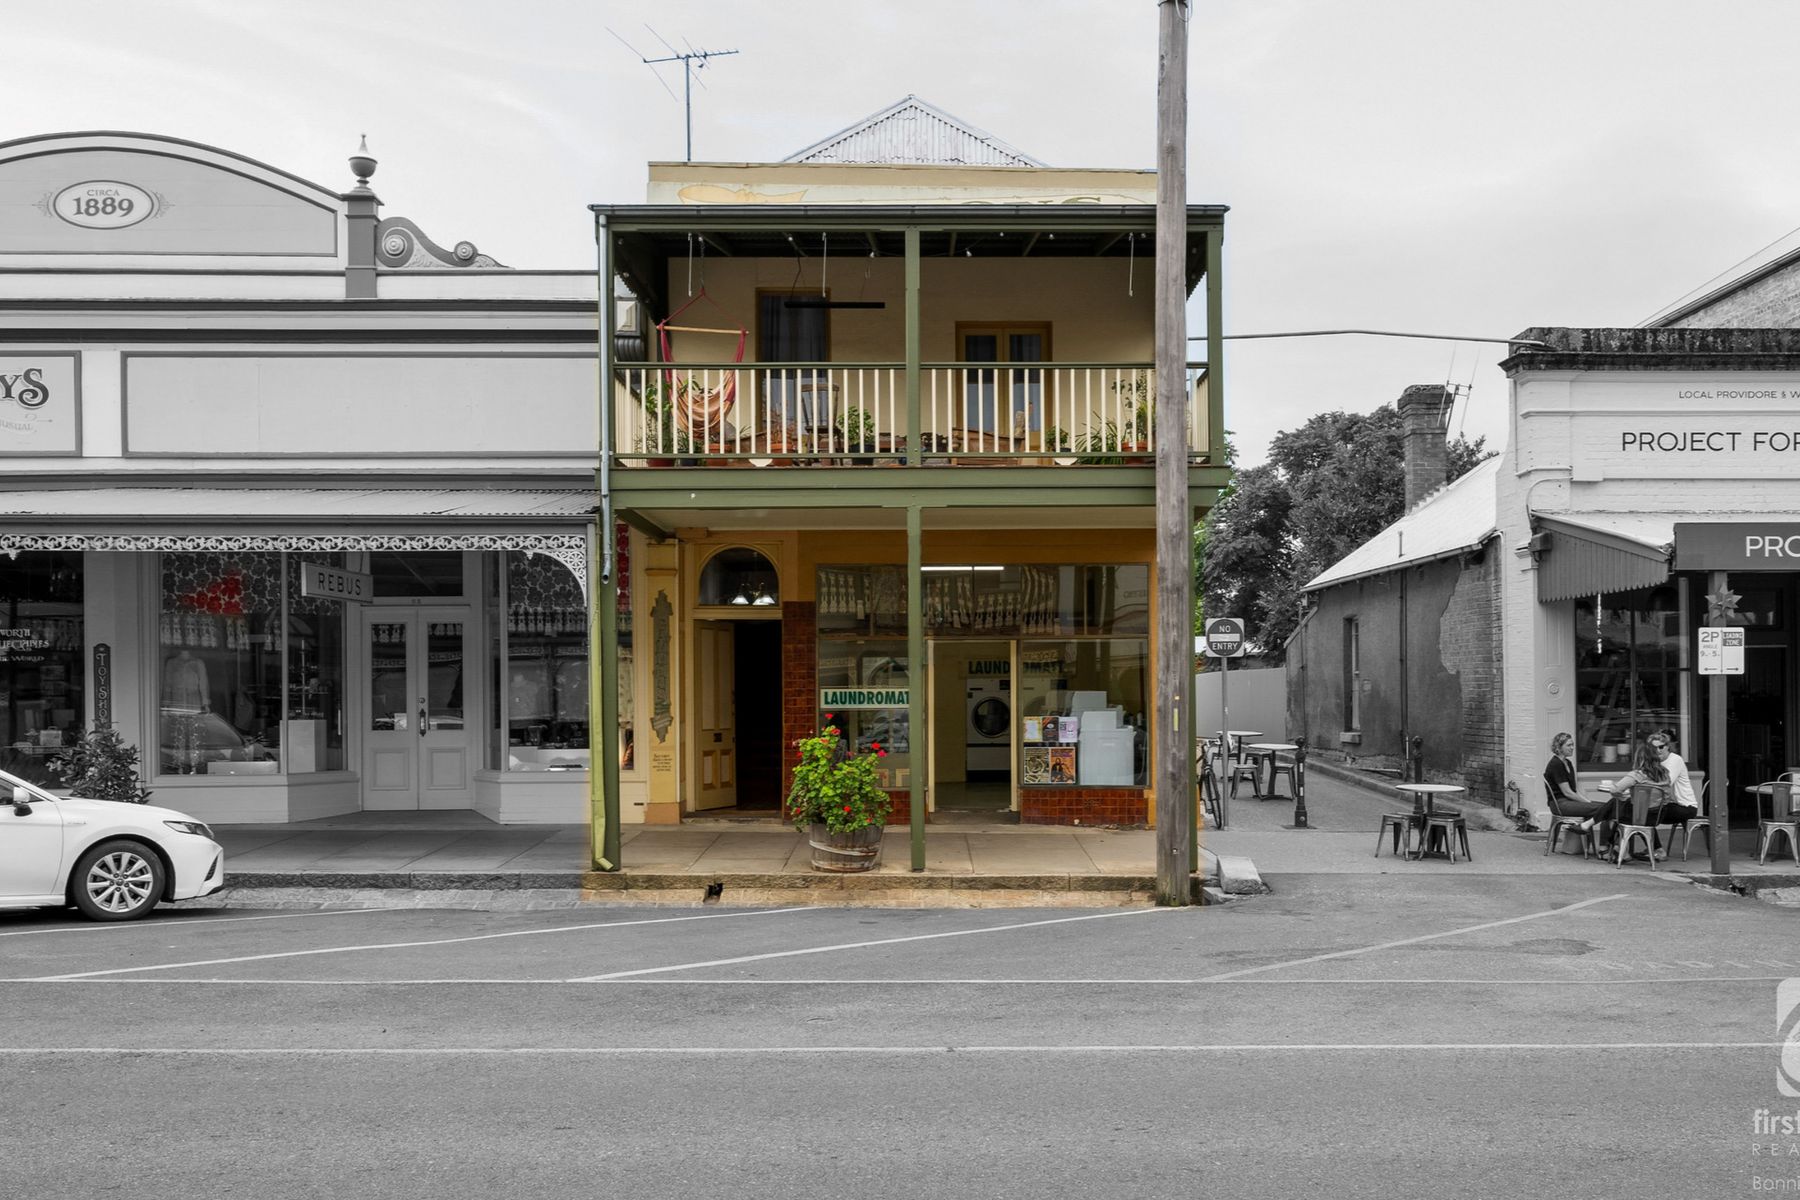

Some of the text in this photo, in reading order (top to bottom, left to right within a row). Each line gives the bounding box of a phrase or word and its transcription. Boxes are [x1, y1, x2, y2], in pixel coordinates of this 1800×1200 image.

[86, 189, 121, 197] CIRCA
[73, 197, 134, 217] 1889
[1679, 391, 1714, 399] LOCAL
[1716, 391, 1777, 399] PROVIDORE
[1622, 431, 1741, 451] PROJECT
[318, 572, 361, 596] REBUS
[1701, 631, 1720, 642] 2P
[1212, 642, 1238, 650] ENTRY
